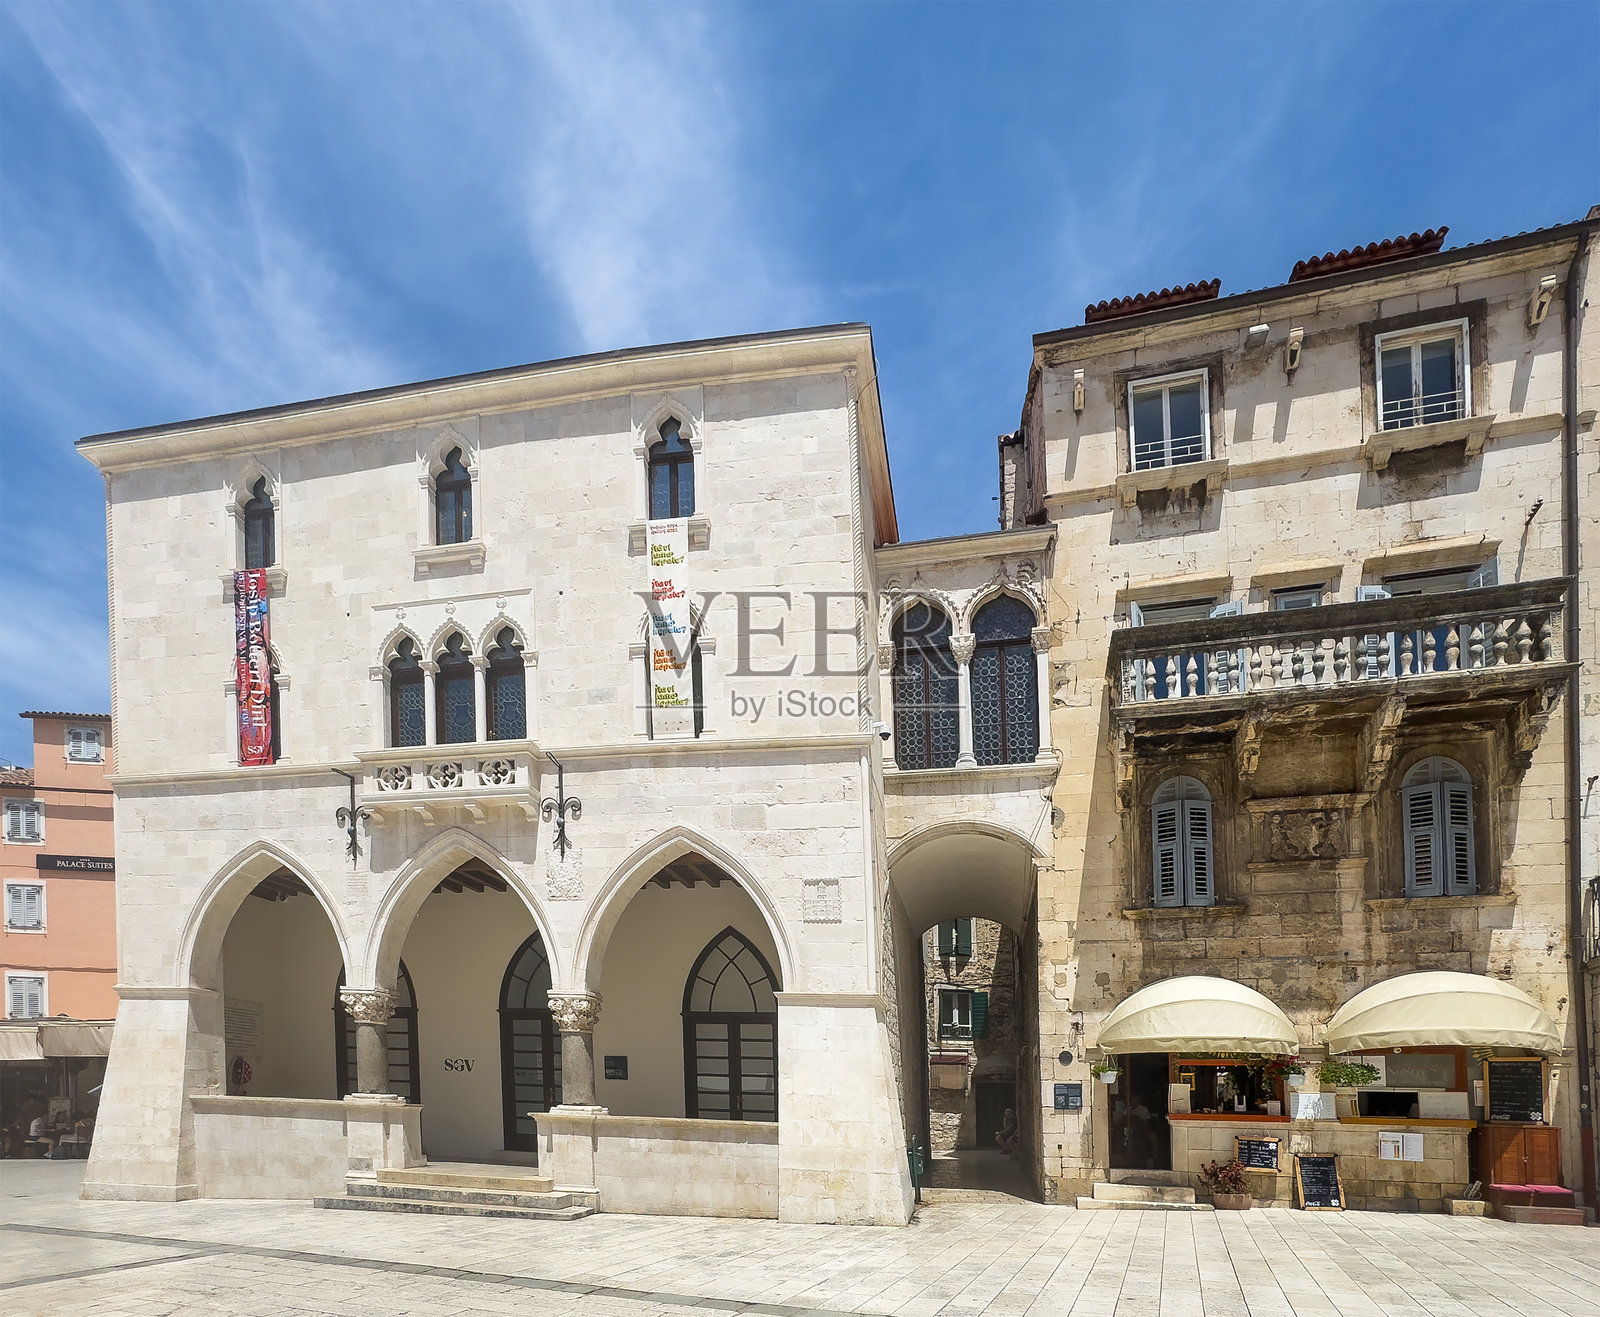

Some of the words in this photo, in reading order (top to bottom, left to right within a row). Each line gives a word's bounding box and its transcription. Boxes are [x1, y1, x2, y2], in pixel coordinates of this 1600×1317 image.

[247, 572, 260, 616] Josip
[249, 621, 264, 683] Botteri
[251, 690, 267, 727] Dini
[444, 1058, 475, 1072] SGV
